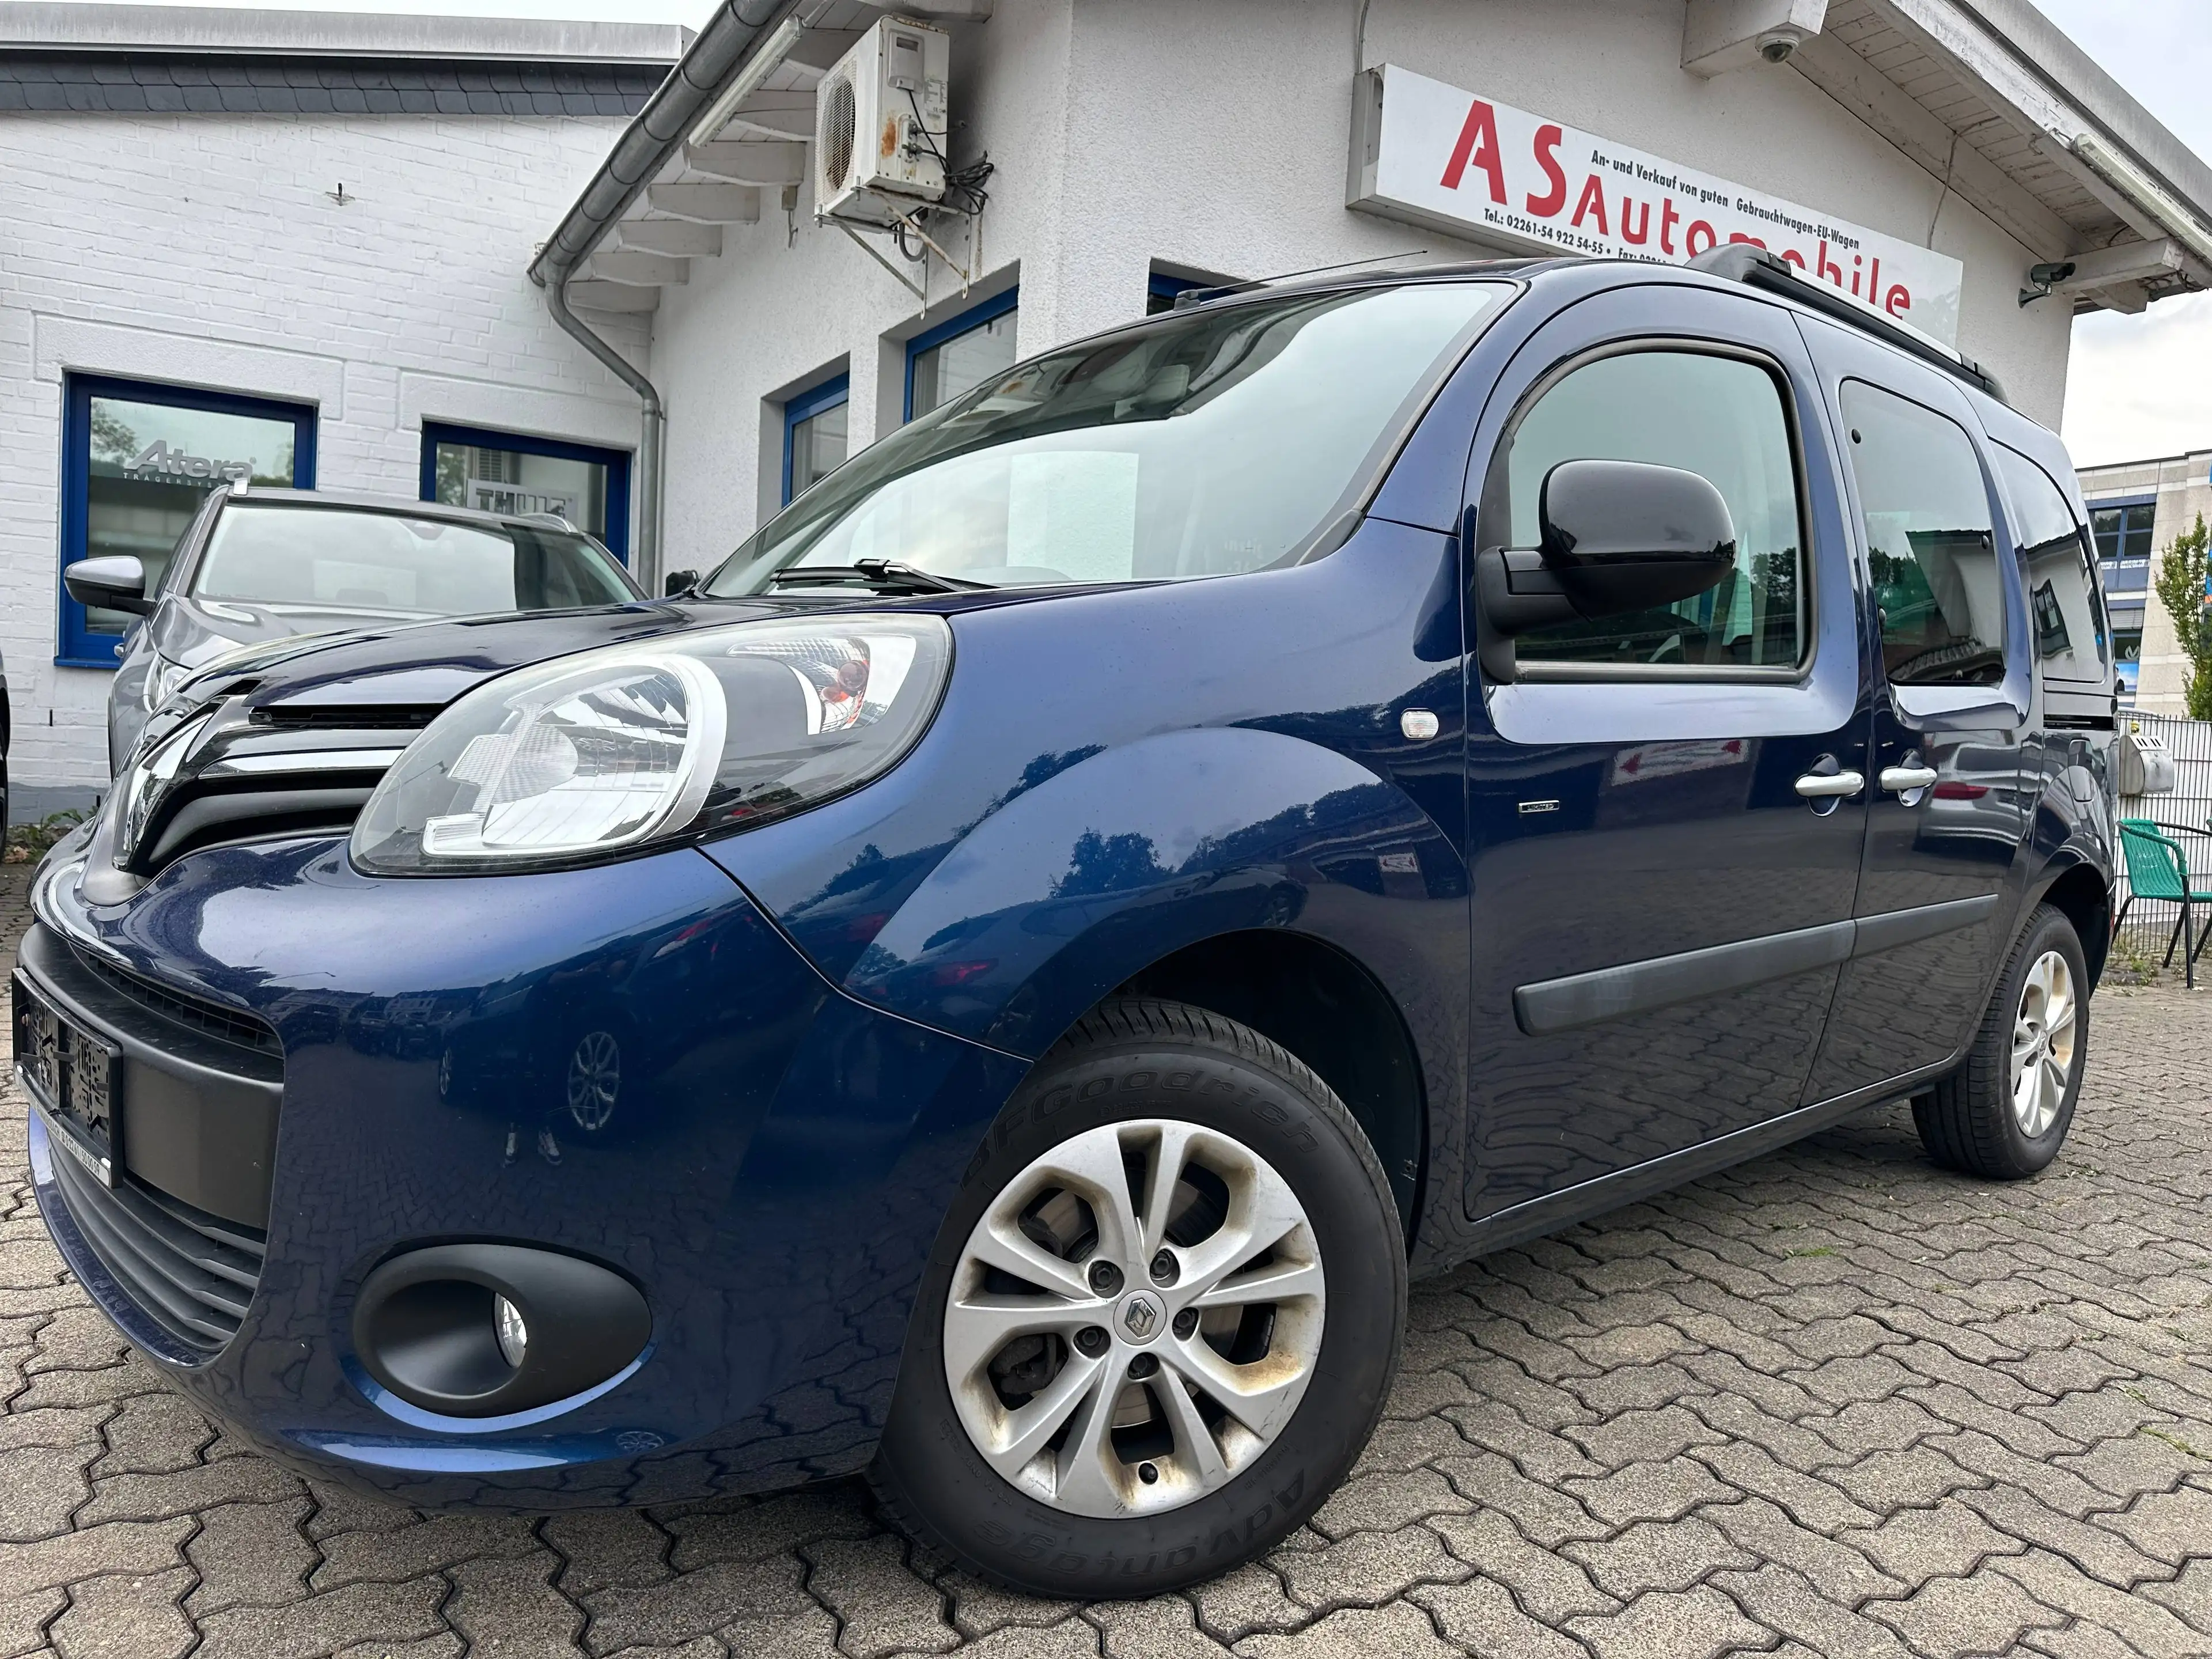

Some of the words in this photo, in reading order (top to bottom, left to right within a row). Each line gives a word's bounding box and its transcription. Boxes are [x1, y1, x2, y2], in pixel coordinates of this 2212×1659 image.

[1592, 150, 1609, 166] An-
[1613, 161, 1633, 175] und
[1637, 163, 1677, 190] Verkauf
[1680, 181, 1697, 196] von
[1700, 189, 1728, 207] guten
[1484, 208, 1503, 225] Tel.:
[1507, 215, 1553, 240] 02261-54
[1556, 230, 1574, 246] 922
[1577, 236, 1603, 255] 54-55
[123, 440, 253, 483] Atera
[974, 1468, 1305, 1578] Advantage
